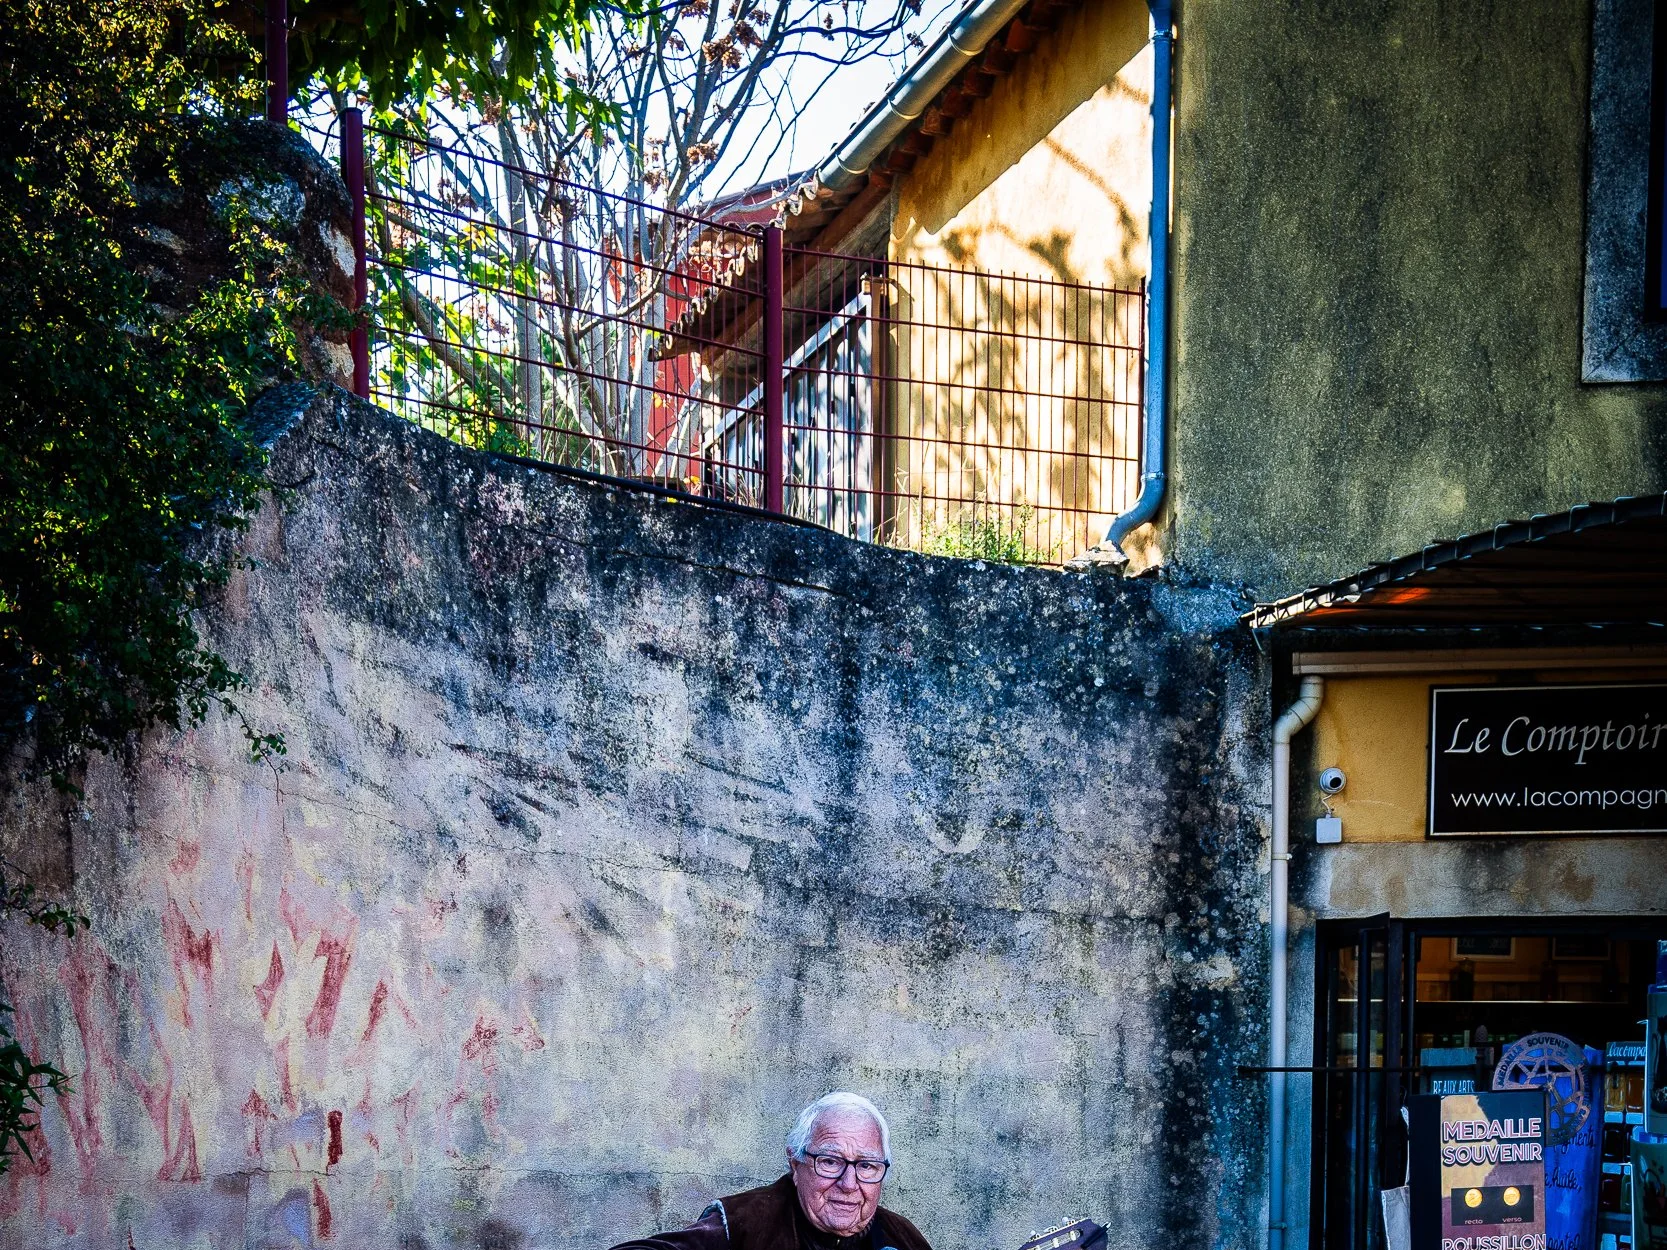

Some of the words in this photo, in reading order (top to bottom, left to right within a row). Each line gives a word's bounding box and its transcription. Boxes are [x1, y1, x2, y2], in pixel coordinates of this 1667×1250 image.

[1443, 717, 1491, 754] Le
[1501, 712, 1667, 765] Comptoir
[1526, 1036, 1570, 1056] SOUVENIR
[1443, 1117, 1542, 1141] MEDAILLE
[1443, 1142, 1543, 1164] SOUVENIR
